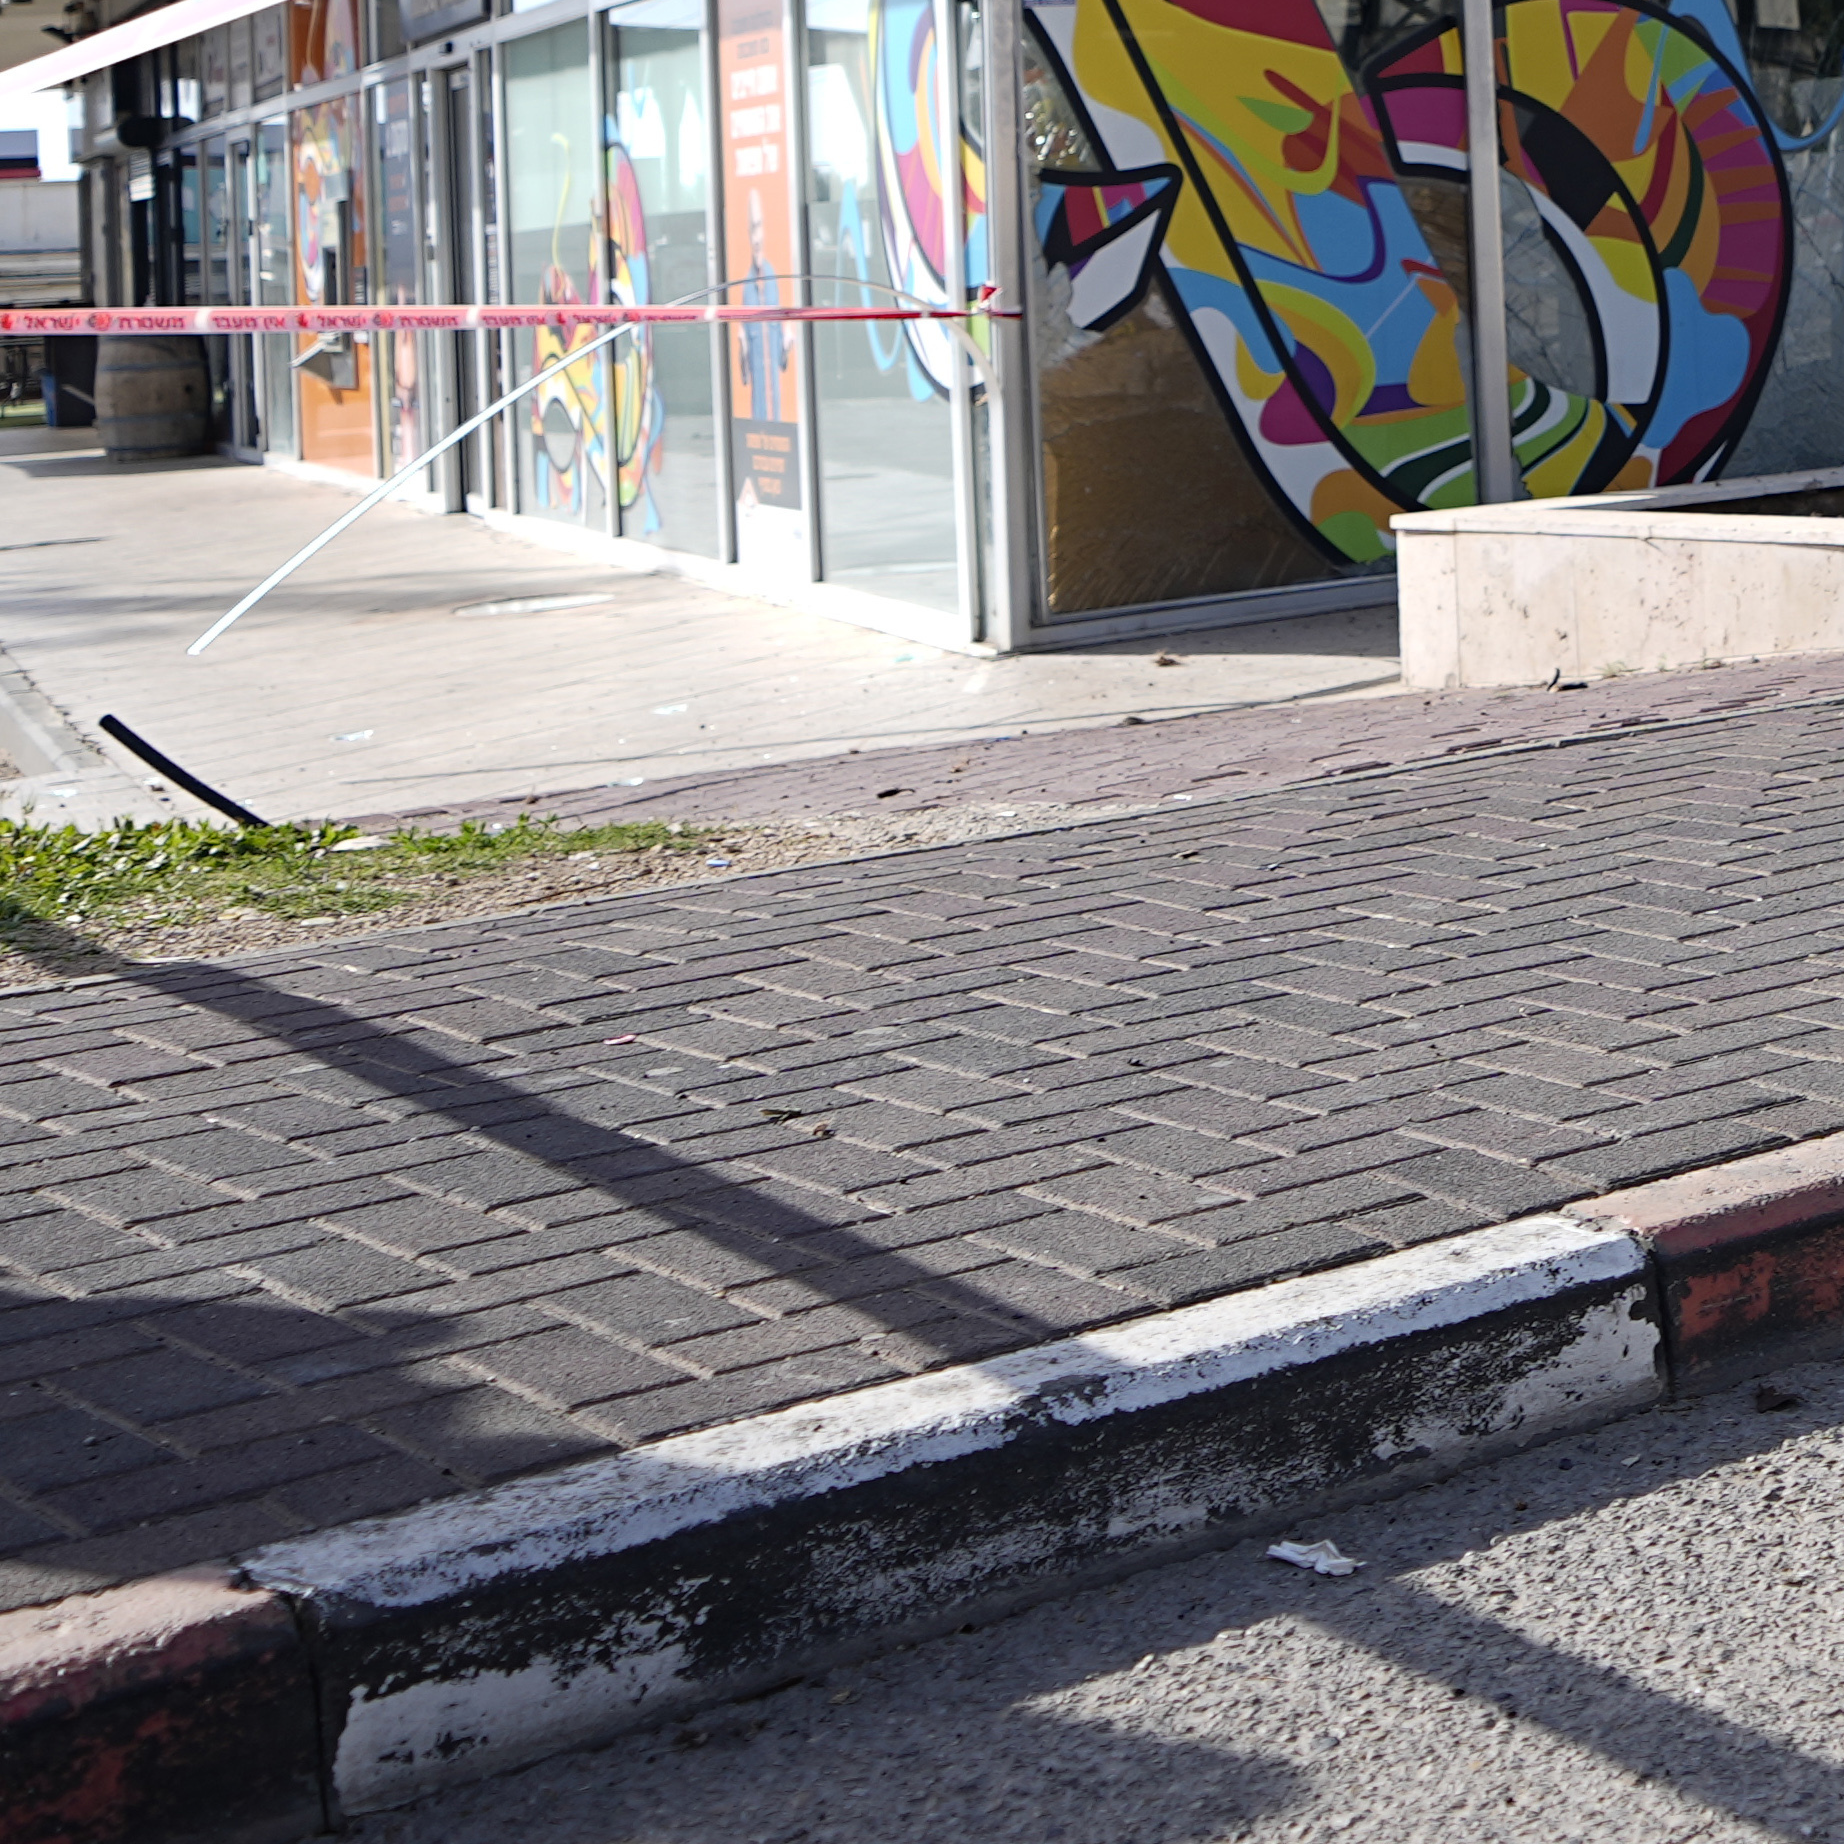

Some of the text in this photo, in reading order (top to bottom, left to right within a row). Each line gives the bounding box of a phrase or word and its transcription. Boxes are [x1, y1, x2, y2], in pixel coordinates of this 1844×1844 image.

[24, 313, 186, 330] משטרת ישראל
[211, 313, 258, 329] מעבר
